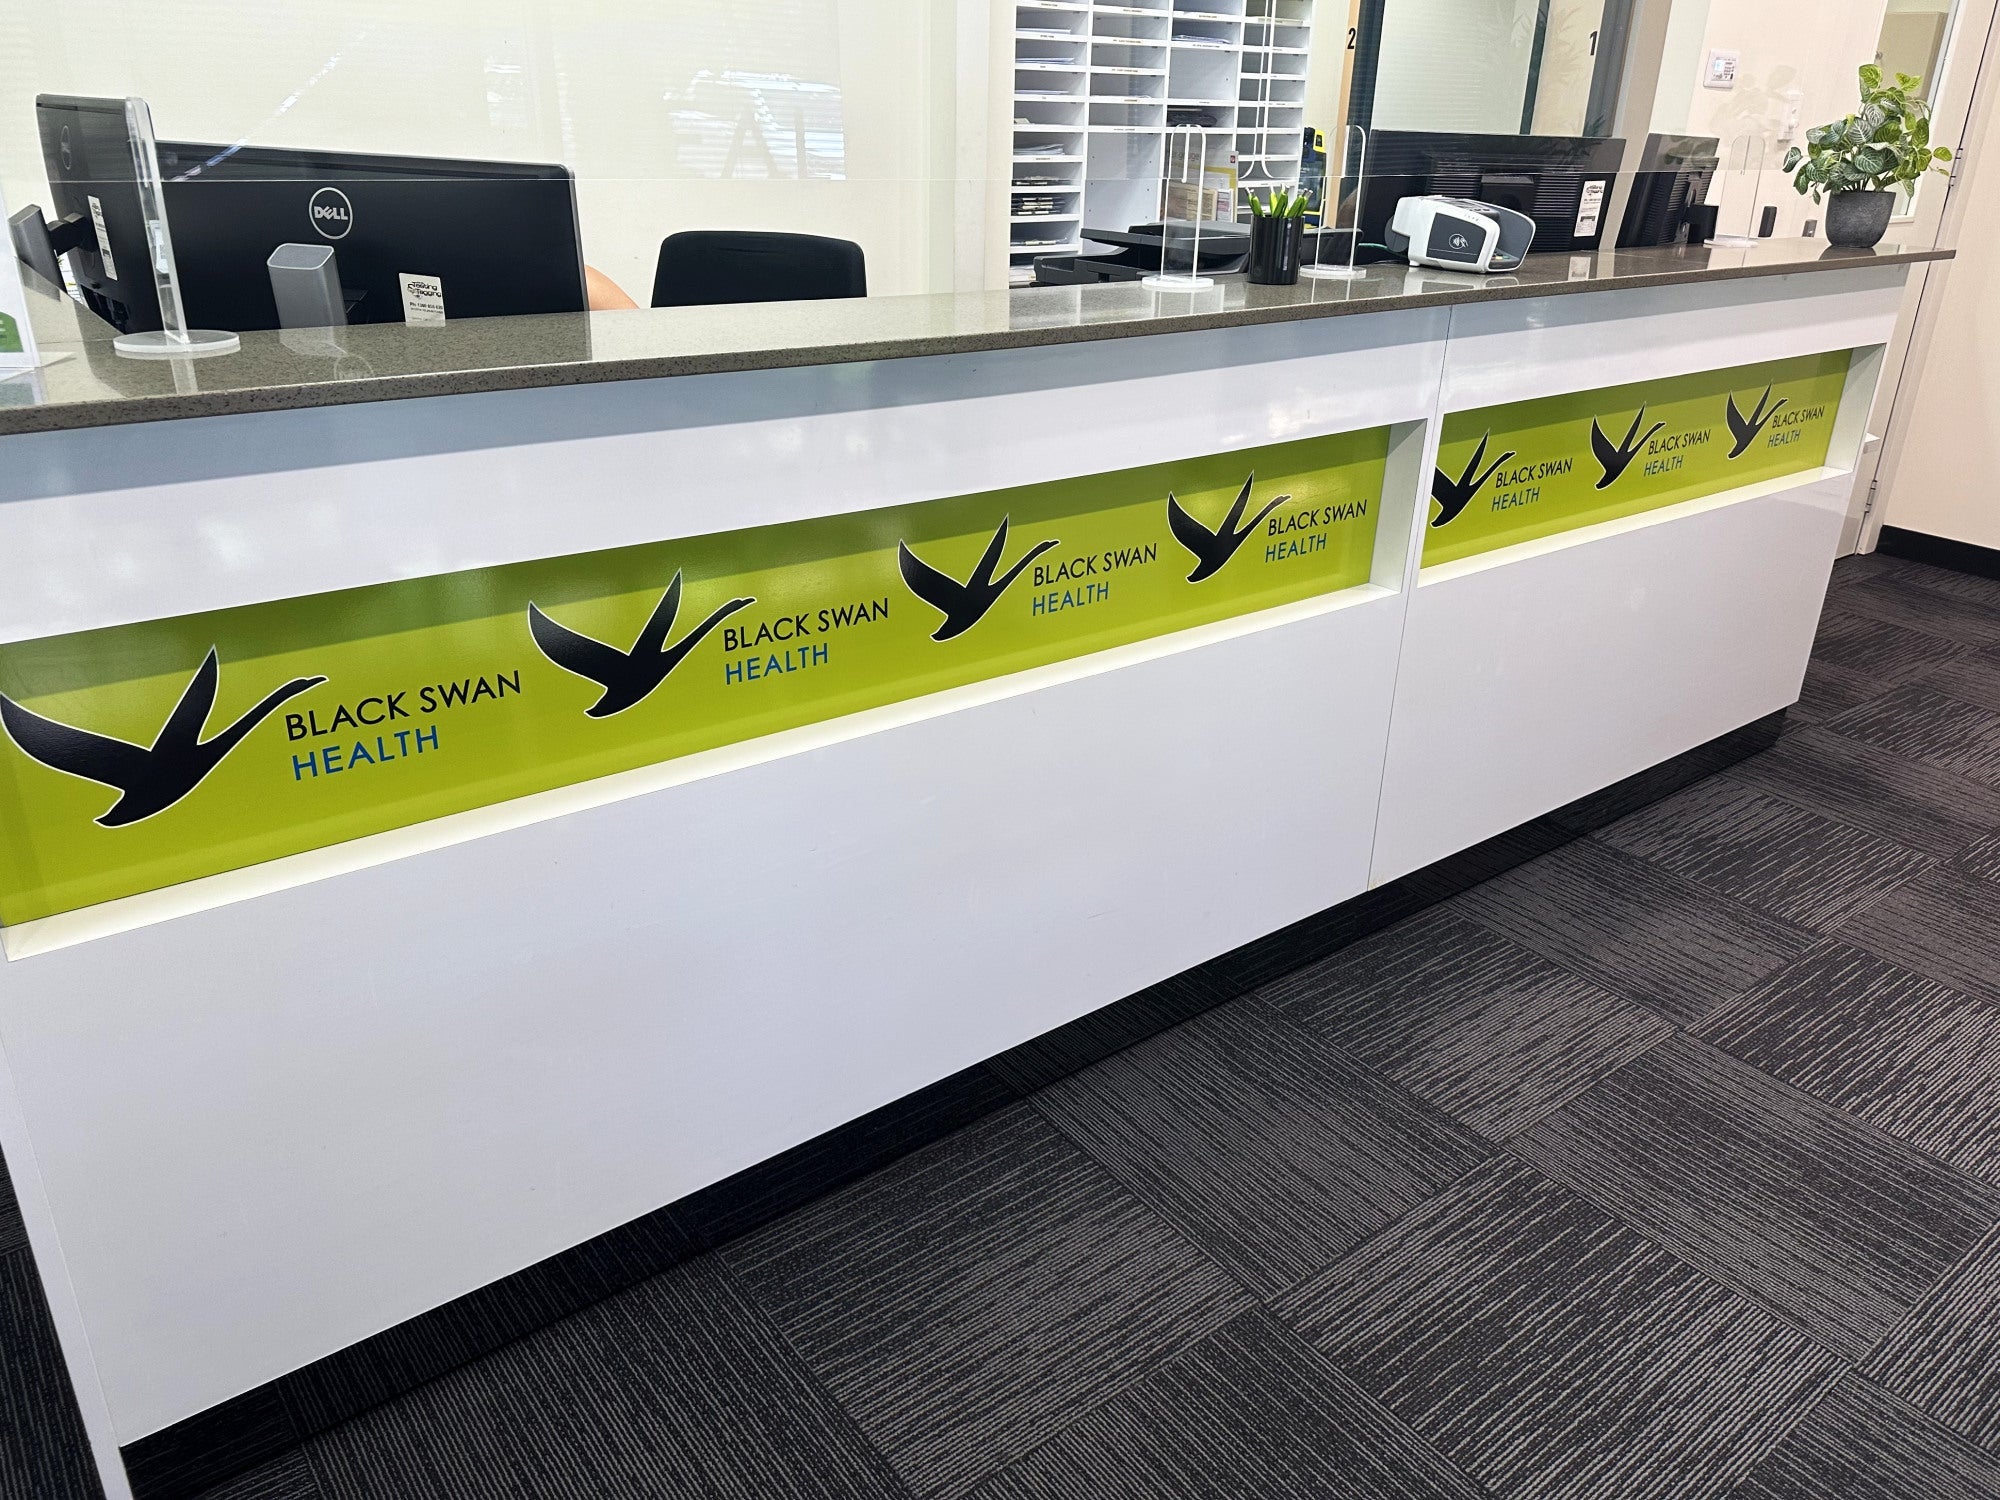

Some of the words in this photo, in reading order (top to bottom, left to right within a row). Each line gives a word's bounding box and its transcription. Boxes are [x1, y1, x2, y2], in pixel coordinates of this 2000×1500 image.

[1347, 27, 1356, 49] 2
[1589, 31, 1598, 56] 1
[313, 205, 349, 220] DELL
[1772, 410, 1800, 429] BLACK
[1800, 405, 1825, 423] SWAN
[1648, 435, 1681, 455] BLACK
[1682, 429, 1711, 448] SWAN
[1767, 428, 1801, 448] HEALTH
[1495, 465, 1537, 488] BLACK
[1537, 457, 1573, 479] SWAN
[1643, 455, 1684, 477] HEALTH
[1491, 486, 1540, 512] HEALTH
[1268, 508, 1320, 536] BLACK
[1322, 499, 1367, 525] SWAN
[1265, 532, 1327, 563] HEALTH
[1033, 554, 1098, 587] BLACK
[1102, 543, 1157, 572] SWAN
[1032, 581, 1109, 616] HEALTH
[723, 613, 810, 652] BLACK
[817, 597, 888, 632] SWAN
[725, 642, 828, 685] HEALTH
[285, 691, 410, 741] BLACK
[419, 670, 521, 713] SWAN
[291, 725, 439, 781] HEALTH
